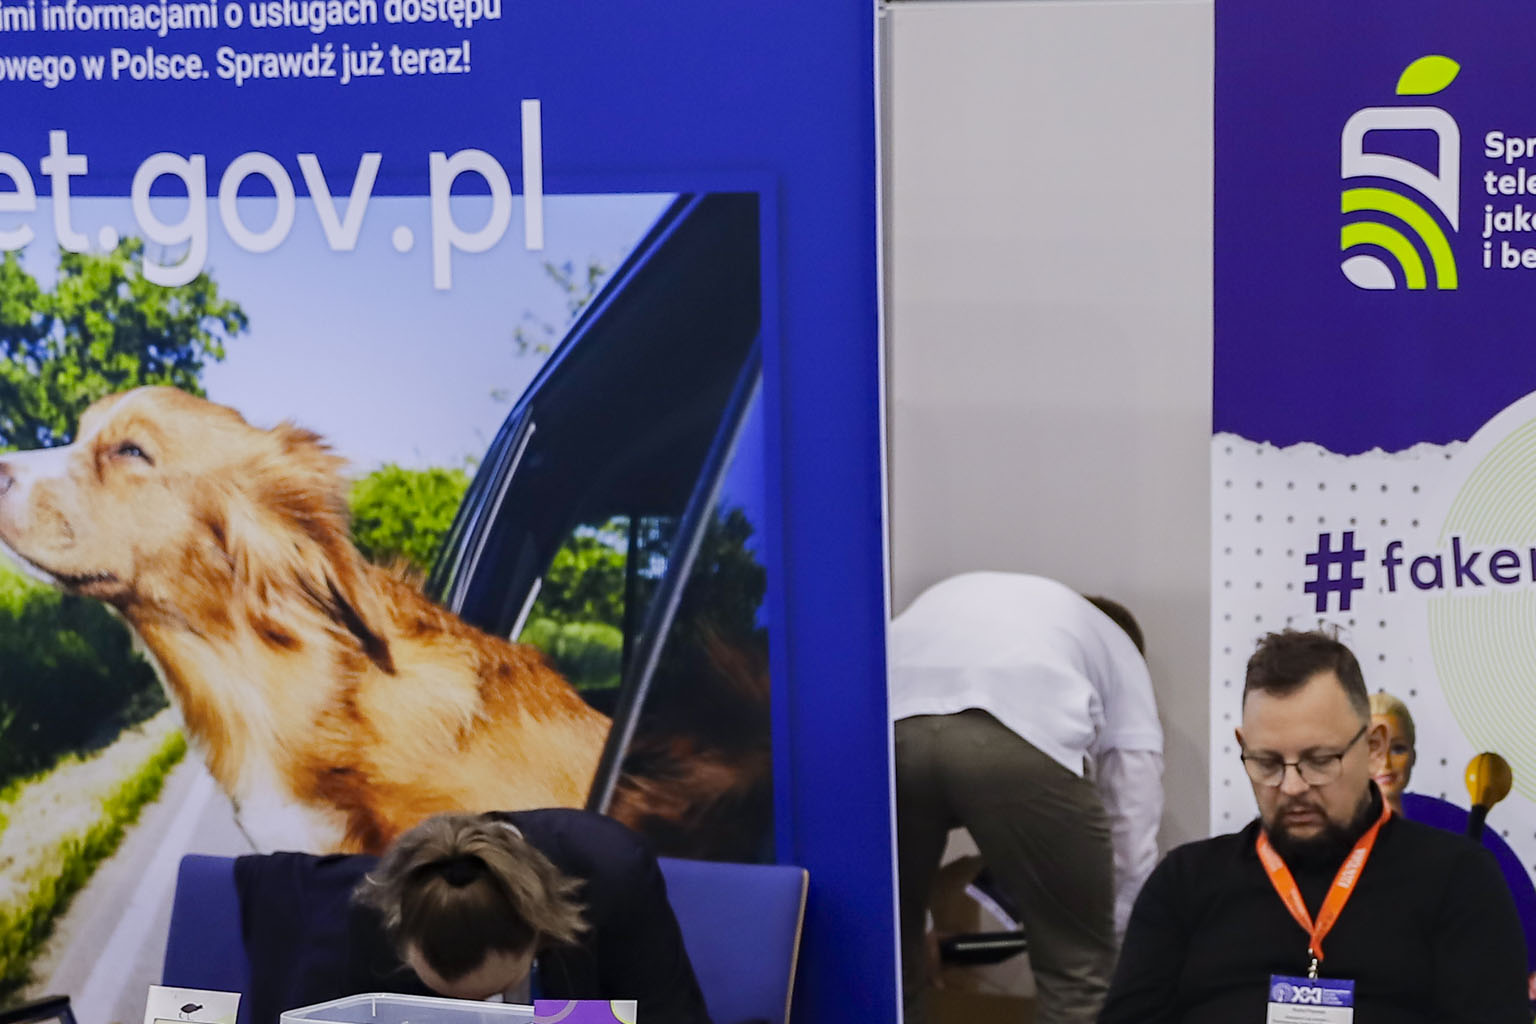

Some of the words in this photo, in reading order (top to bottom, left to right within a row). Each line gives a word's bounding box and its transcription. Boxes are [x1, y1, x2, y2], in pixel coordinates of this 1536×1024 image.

[42, 0, 219, 34] informacjami
[225, 8, 243, 29] o
[250, 0, 378, 33] usługach
[383, 0, 502, 28] dostępu
[82, 55, 105, 80] w
[111, 47, 208, 81] Polsce.
[216, 43, 336, 85] Sprawdź
[341, 45, 383, 82] już
[390, 42, 470, 75] teraz!
[1483, 242, 1492, 269] i
